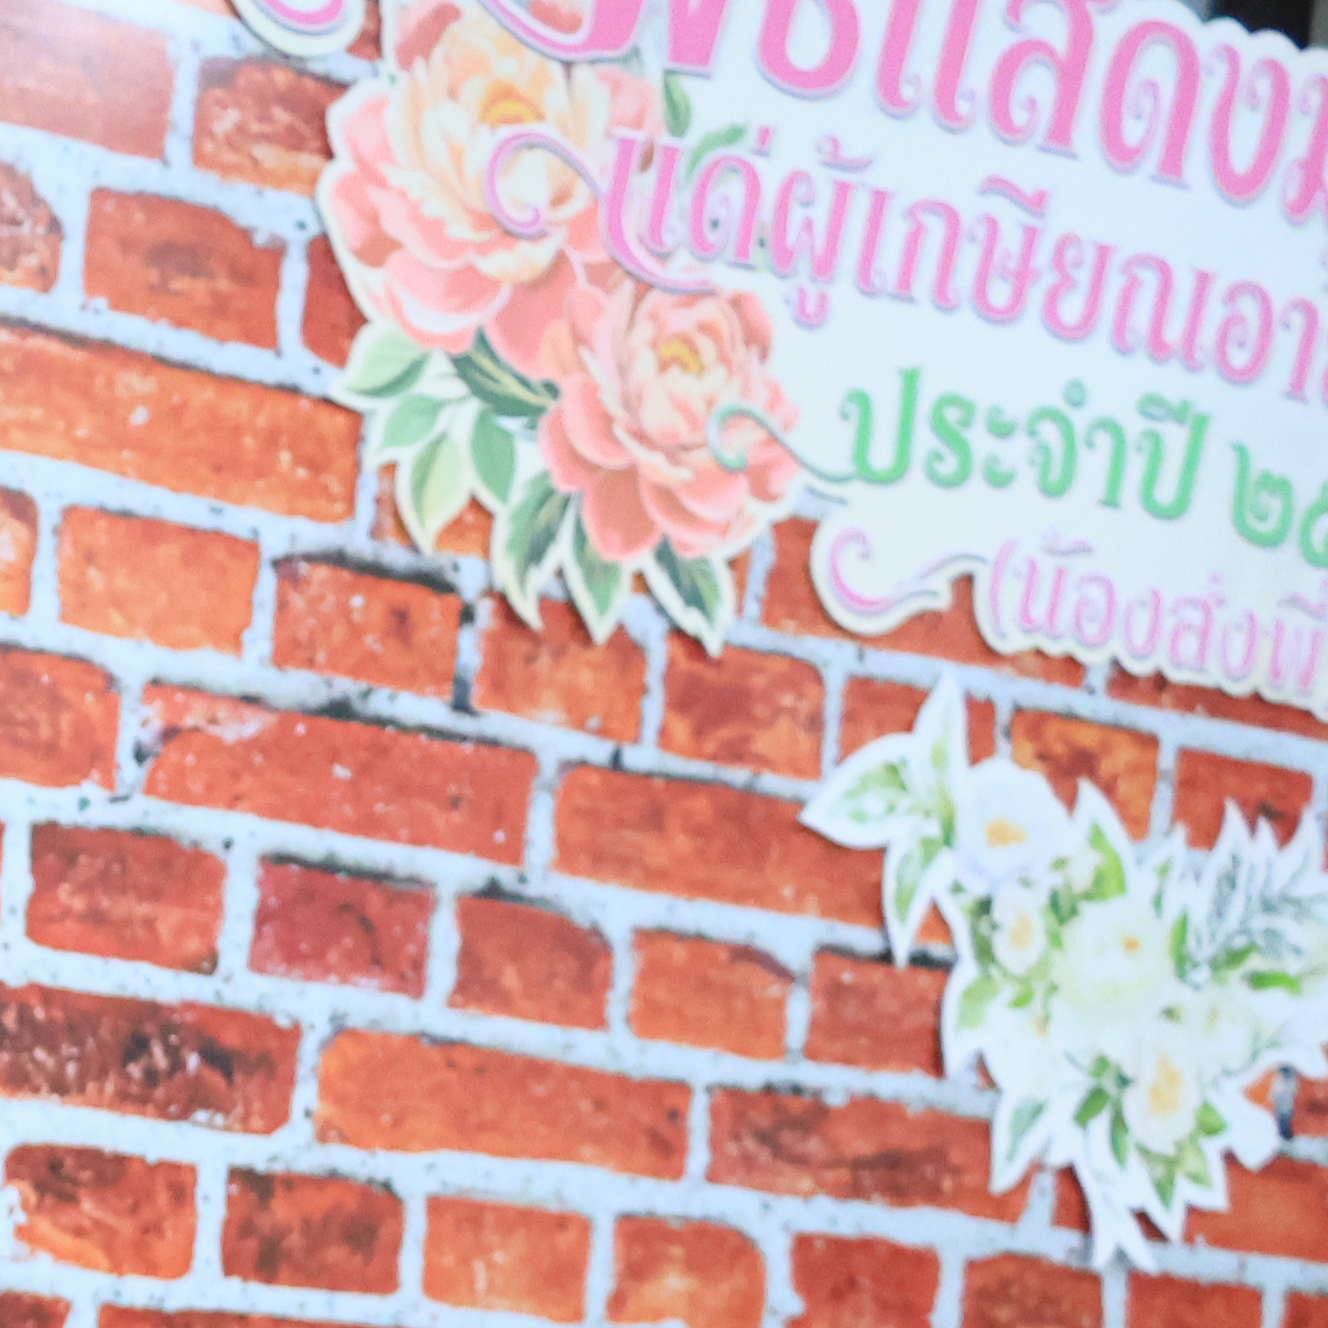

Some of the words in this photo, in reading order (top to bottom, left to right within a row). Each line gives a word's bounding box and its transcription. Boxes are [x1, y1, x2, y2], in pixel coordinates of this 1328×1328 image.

[544, 122, 1328, 404] แด่ผู้เกษียณอา
[824, 364, 1212, 523] ประจำปี
[990, 530, 1328, 698] (น้องส่งพี
